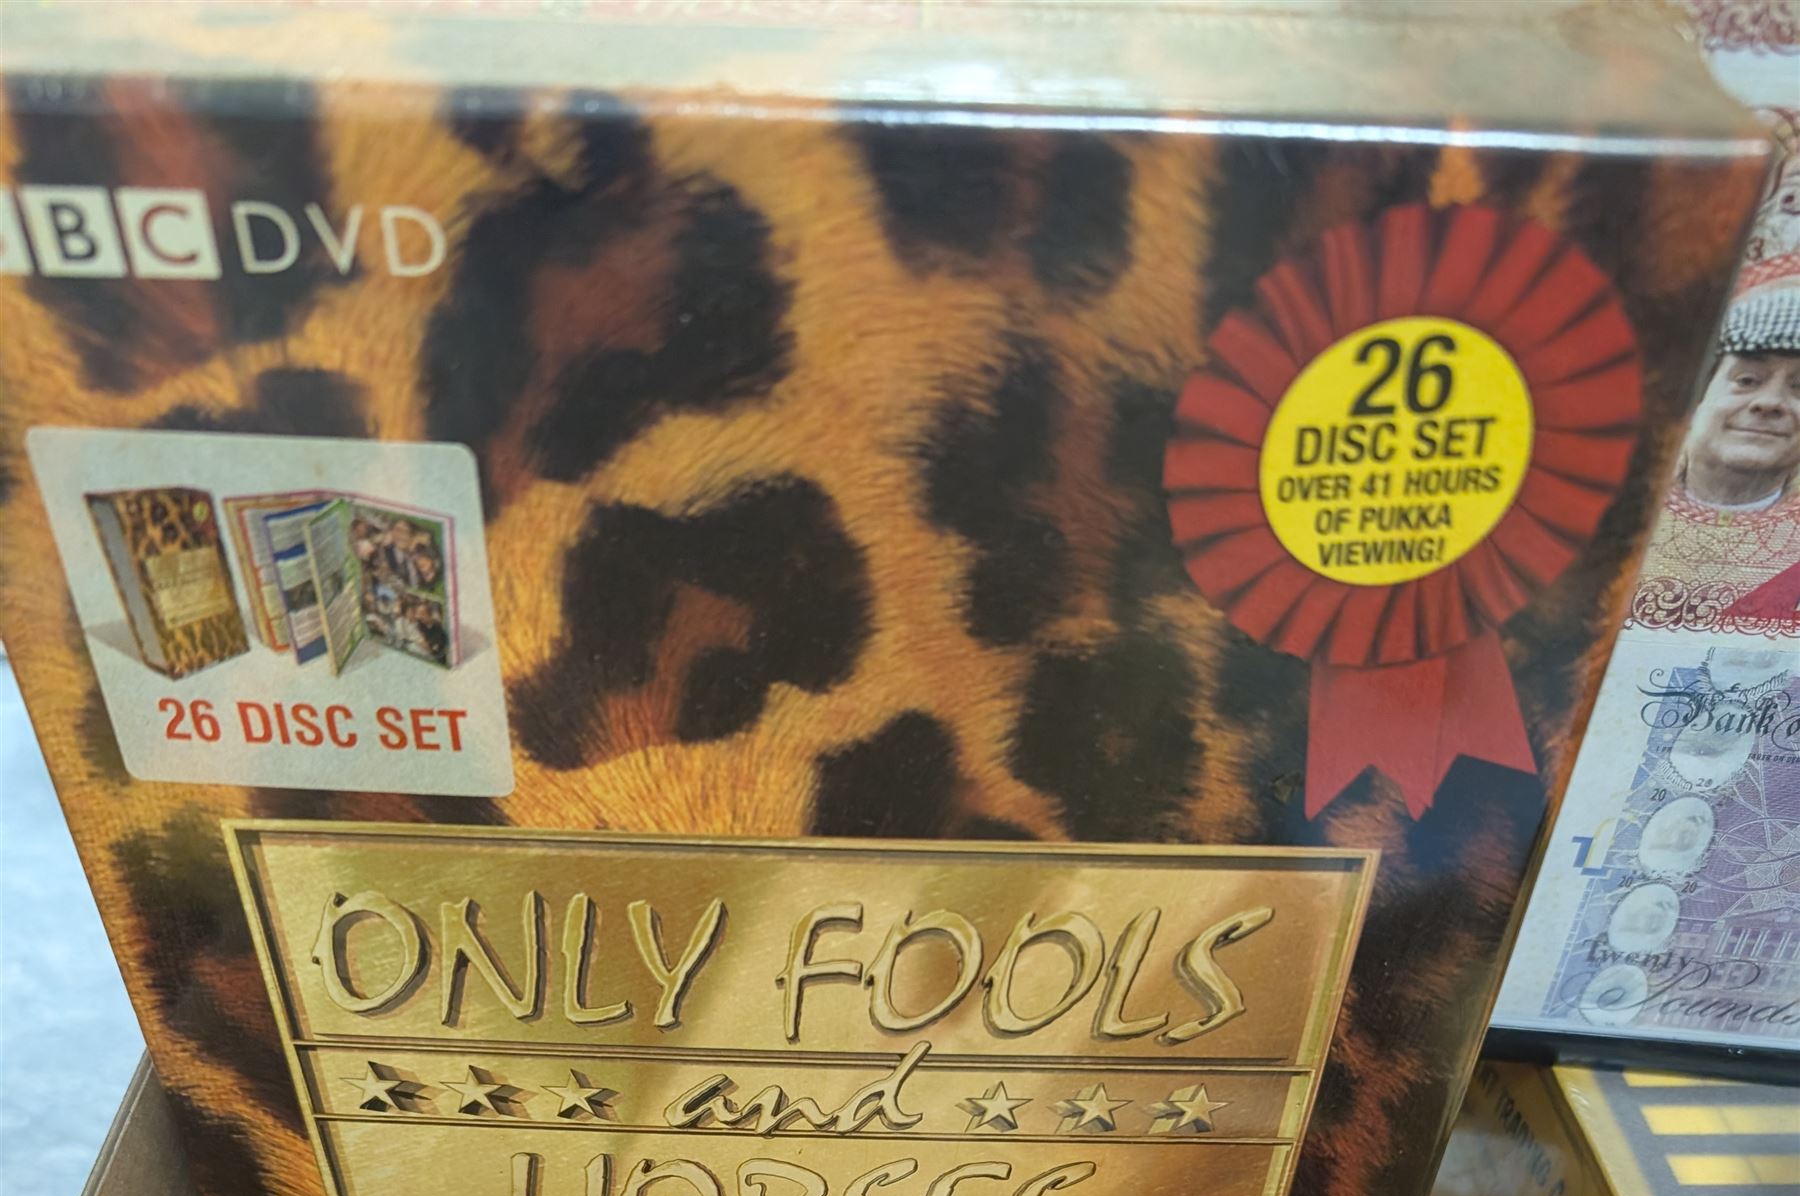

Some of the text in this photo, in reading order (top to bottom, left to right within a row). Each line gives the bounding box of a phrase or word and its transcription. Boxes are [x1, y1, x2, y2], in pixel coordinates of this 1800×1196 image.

[231, 202, 448, 278] DVD
[1348, 333, 1458, 418] 26
[1293, 416, 1497, 468] DISC SET
[1276, 465, 1502, 504] OVER 41 HOURS
[1313, 503, 1453, 535] OF PUKKA
[1317, 538, 1446, 568] VIEWING!
[157, 697, 469, 753] 26 DISC SET
[1651, 788, 1667, 801] 20
[311, 889, 1276, 1047] ONLY FOOLS
[662, 1039, 932, 1138] and
